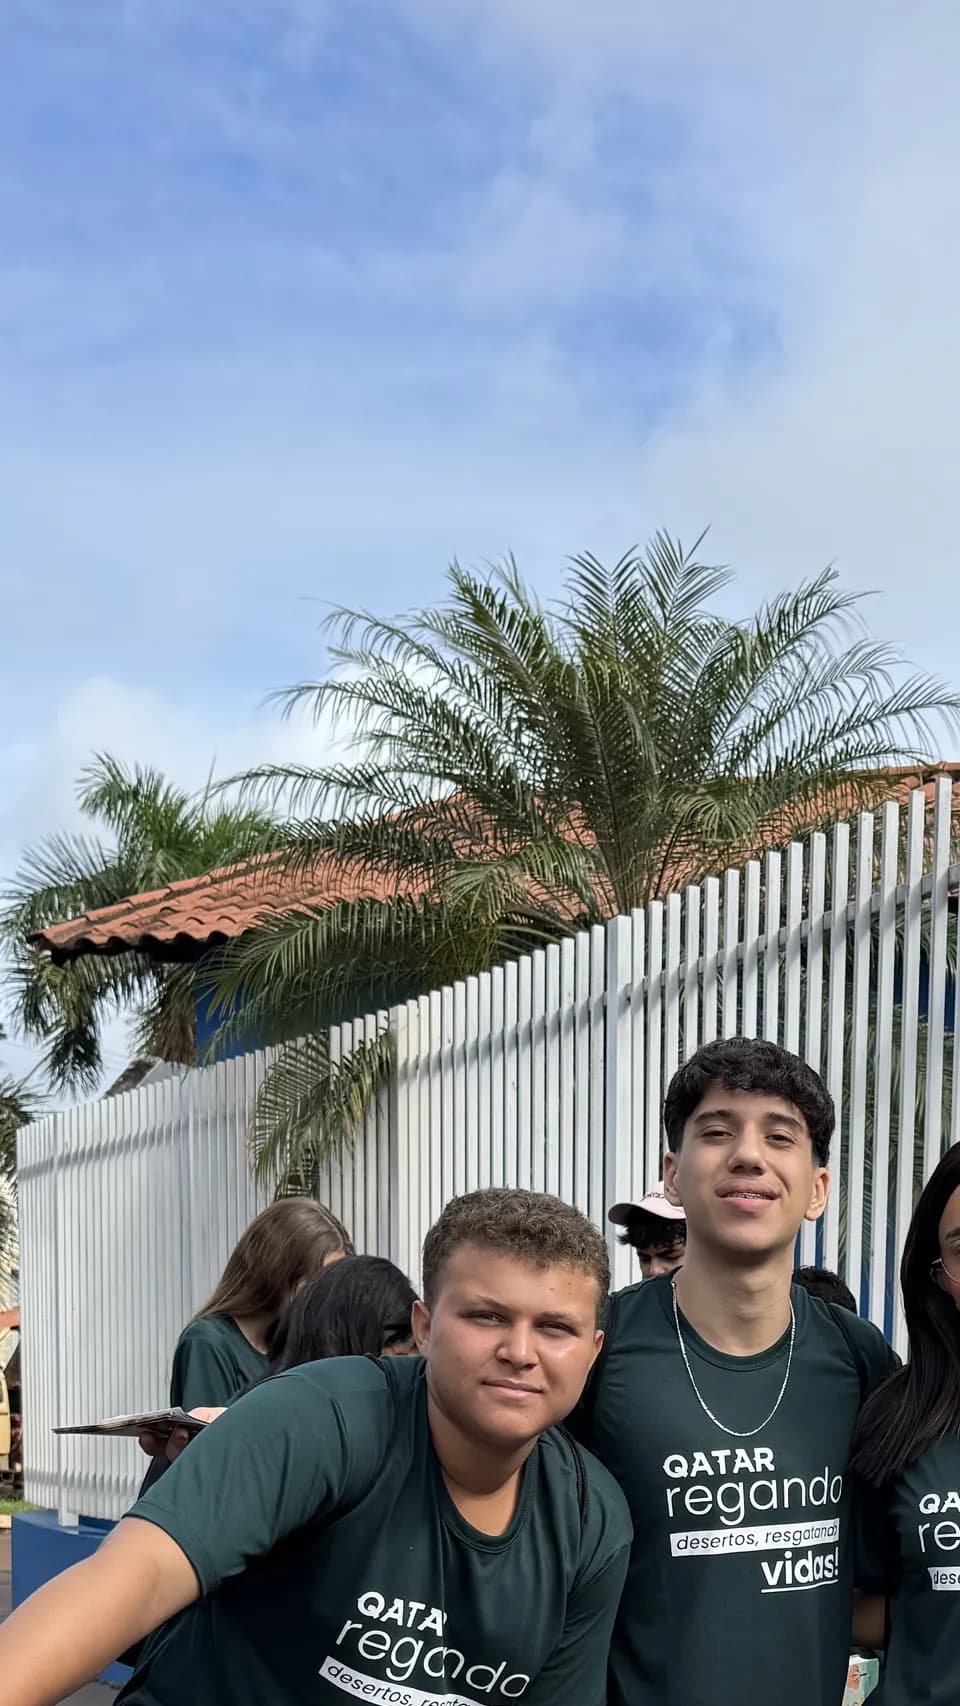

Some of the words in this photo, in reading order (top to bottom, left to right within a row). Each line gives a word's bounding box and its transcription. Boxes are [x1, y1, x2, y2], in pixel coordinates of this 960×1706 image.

[662, 1447, 775, 1479] QATAR
[665, 1466, 843, 1526] regando
[676, 1531, 760, 1551] desertos,
[760, 1546, 839, 1586] vidas!
[356, 1591, 448, 1637] QATA
